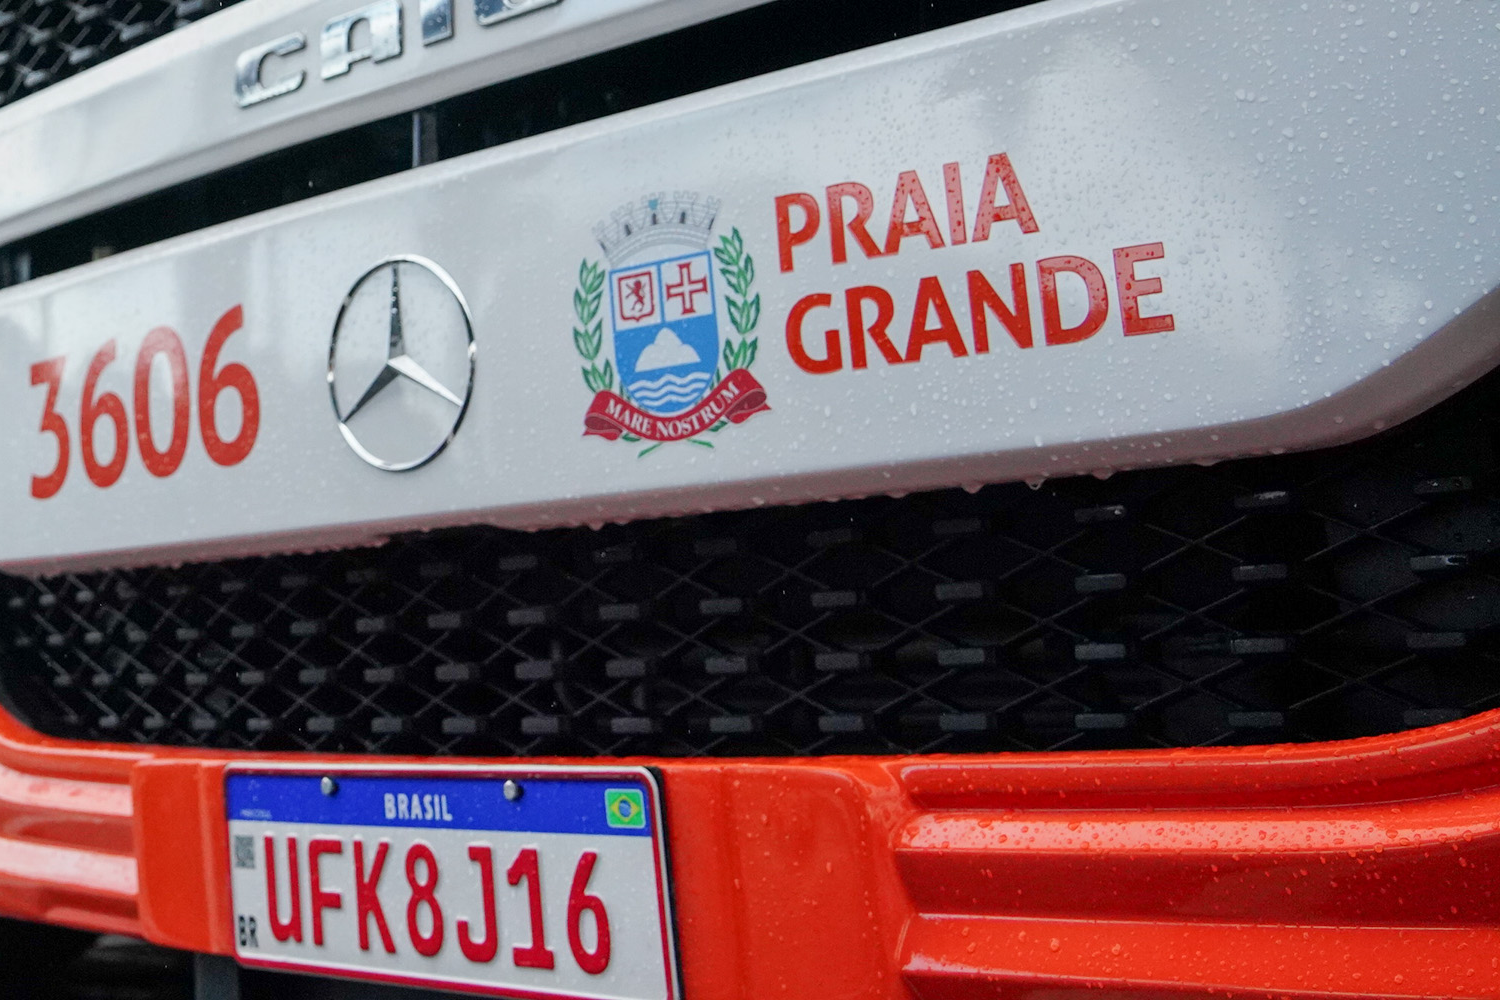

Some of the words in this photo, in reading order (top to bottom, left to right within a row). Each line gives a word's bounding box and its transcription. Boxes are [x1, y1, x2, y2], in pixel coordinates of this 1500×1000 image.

[773, 151, 1040, 274] PRAIA
[784, 241, 1176, 376] GRANDE
[28, 302, 261, 500] 3606
[605, 398, 652, 436] MARE
[654, 380, 741, 438] NOSTRUM
[383, 793, 453, 822] BRASIL
[238, 915, 259, 949] BR
[263, 834, 612, 976] UFK8J16
